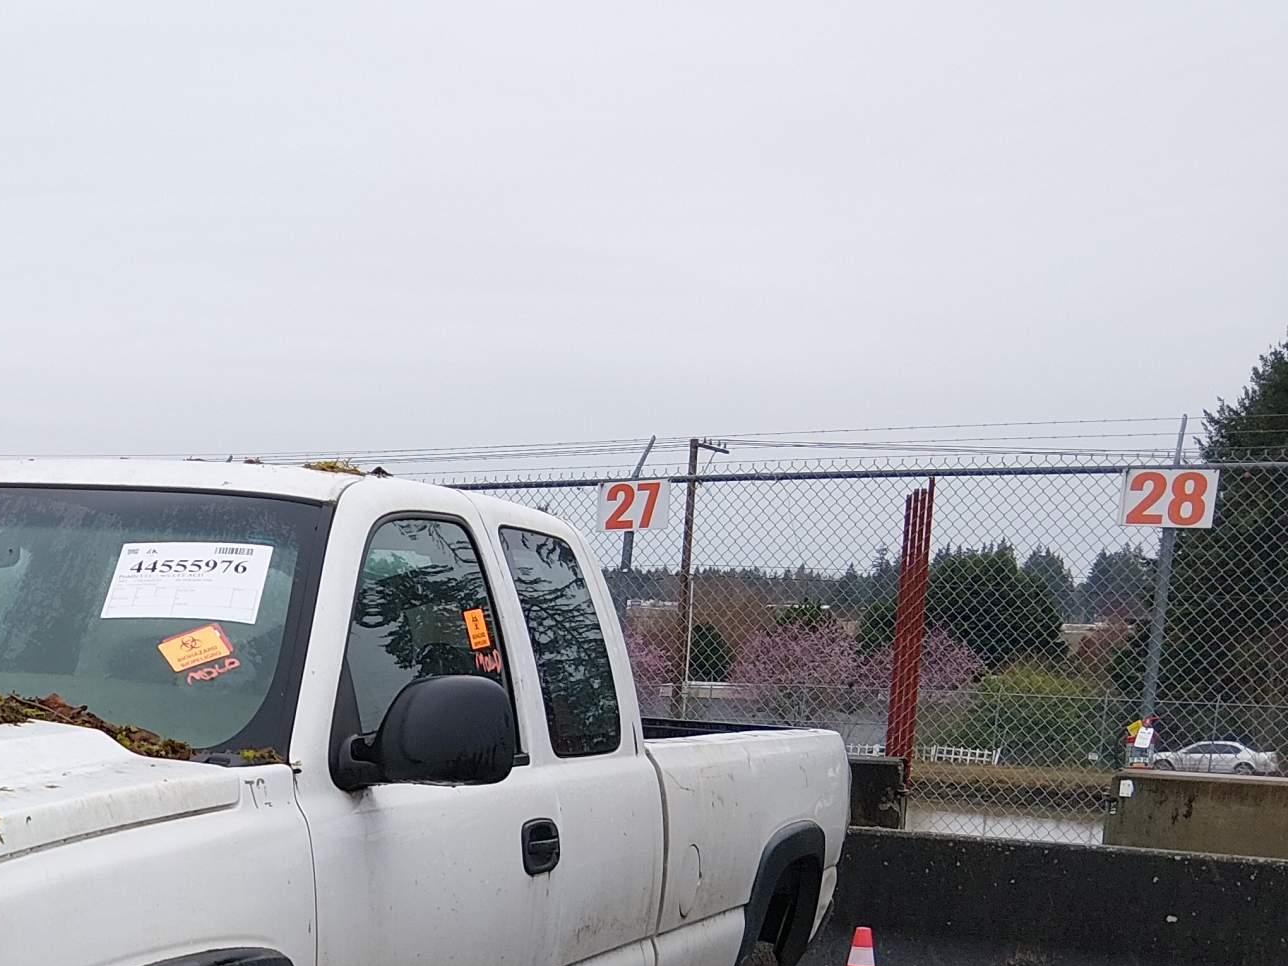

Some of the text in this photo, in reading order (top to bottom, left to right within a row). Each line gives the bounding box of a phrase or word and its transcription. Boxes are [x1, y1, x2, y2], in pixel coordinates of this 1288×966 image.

[605, 481, 661, 530] 27
[1125, 471, 1208, 526] 28
[129, 559, 248, 574] 44555976
